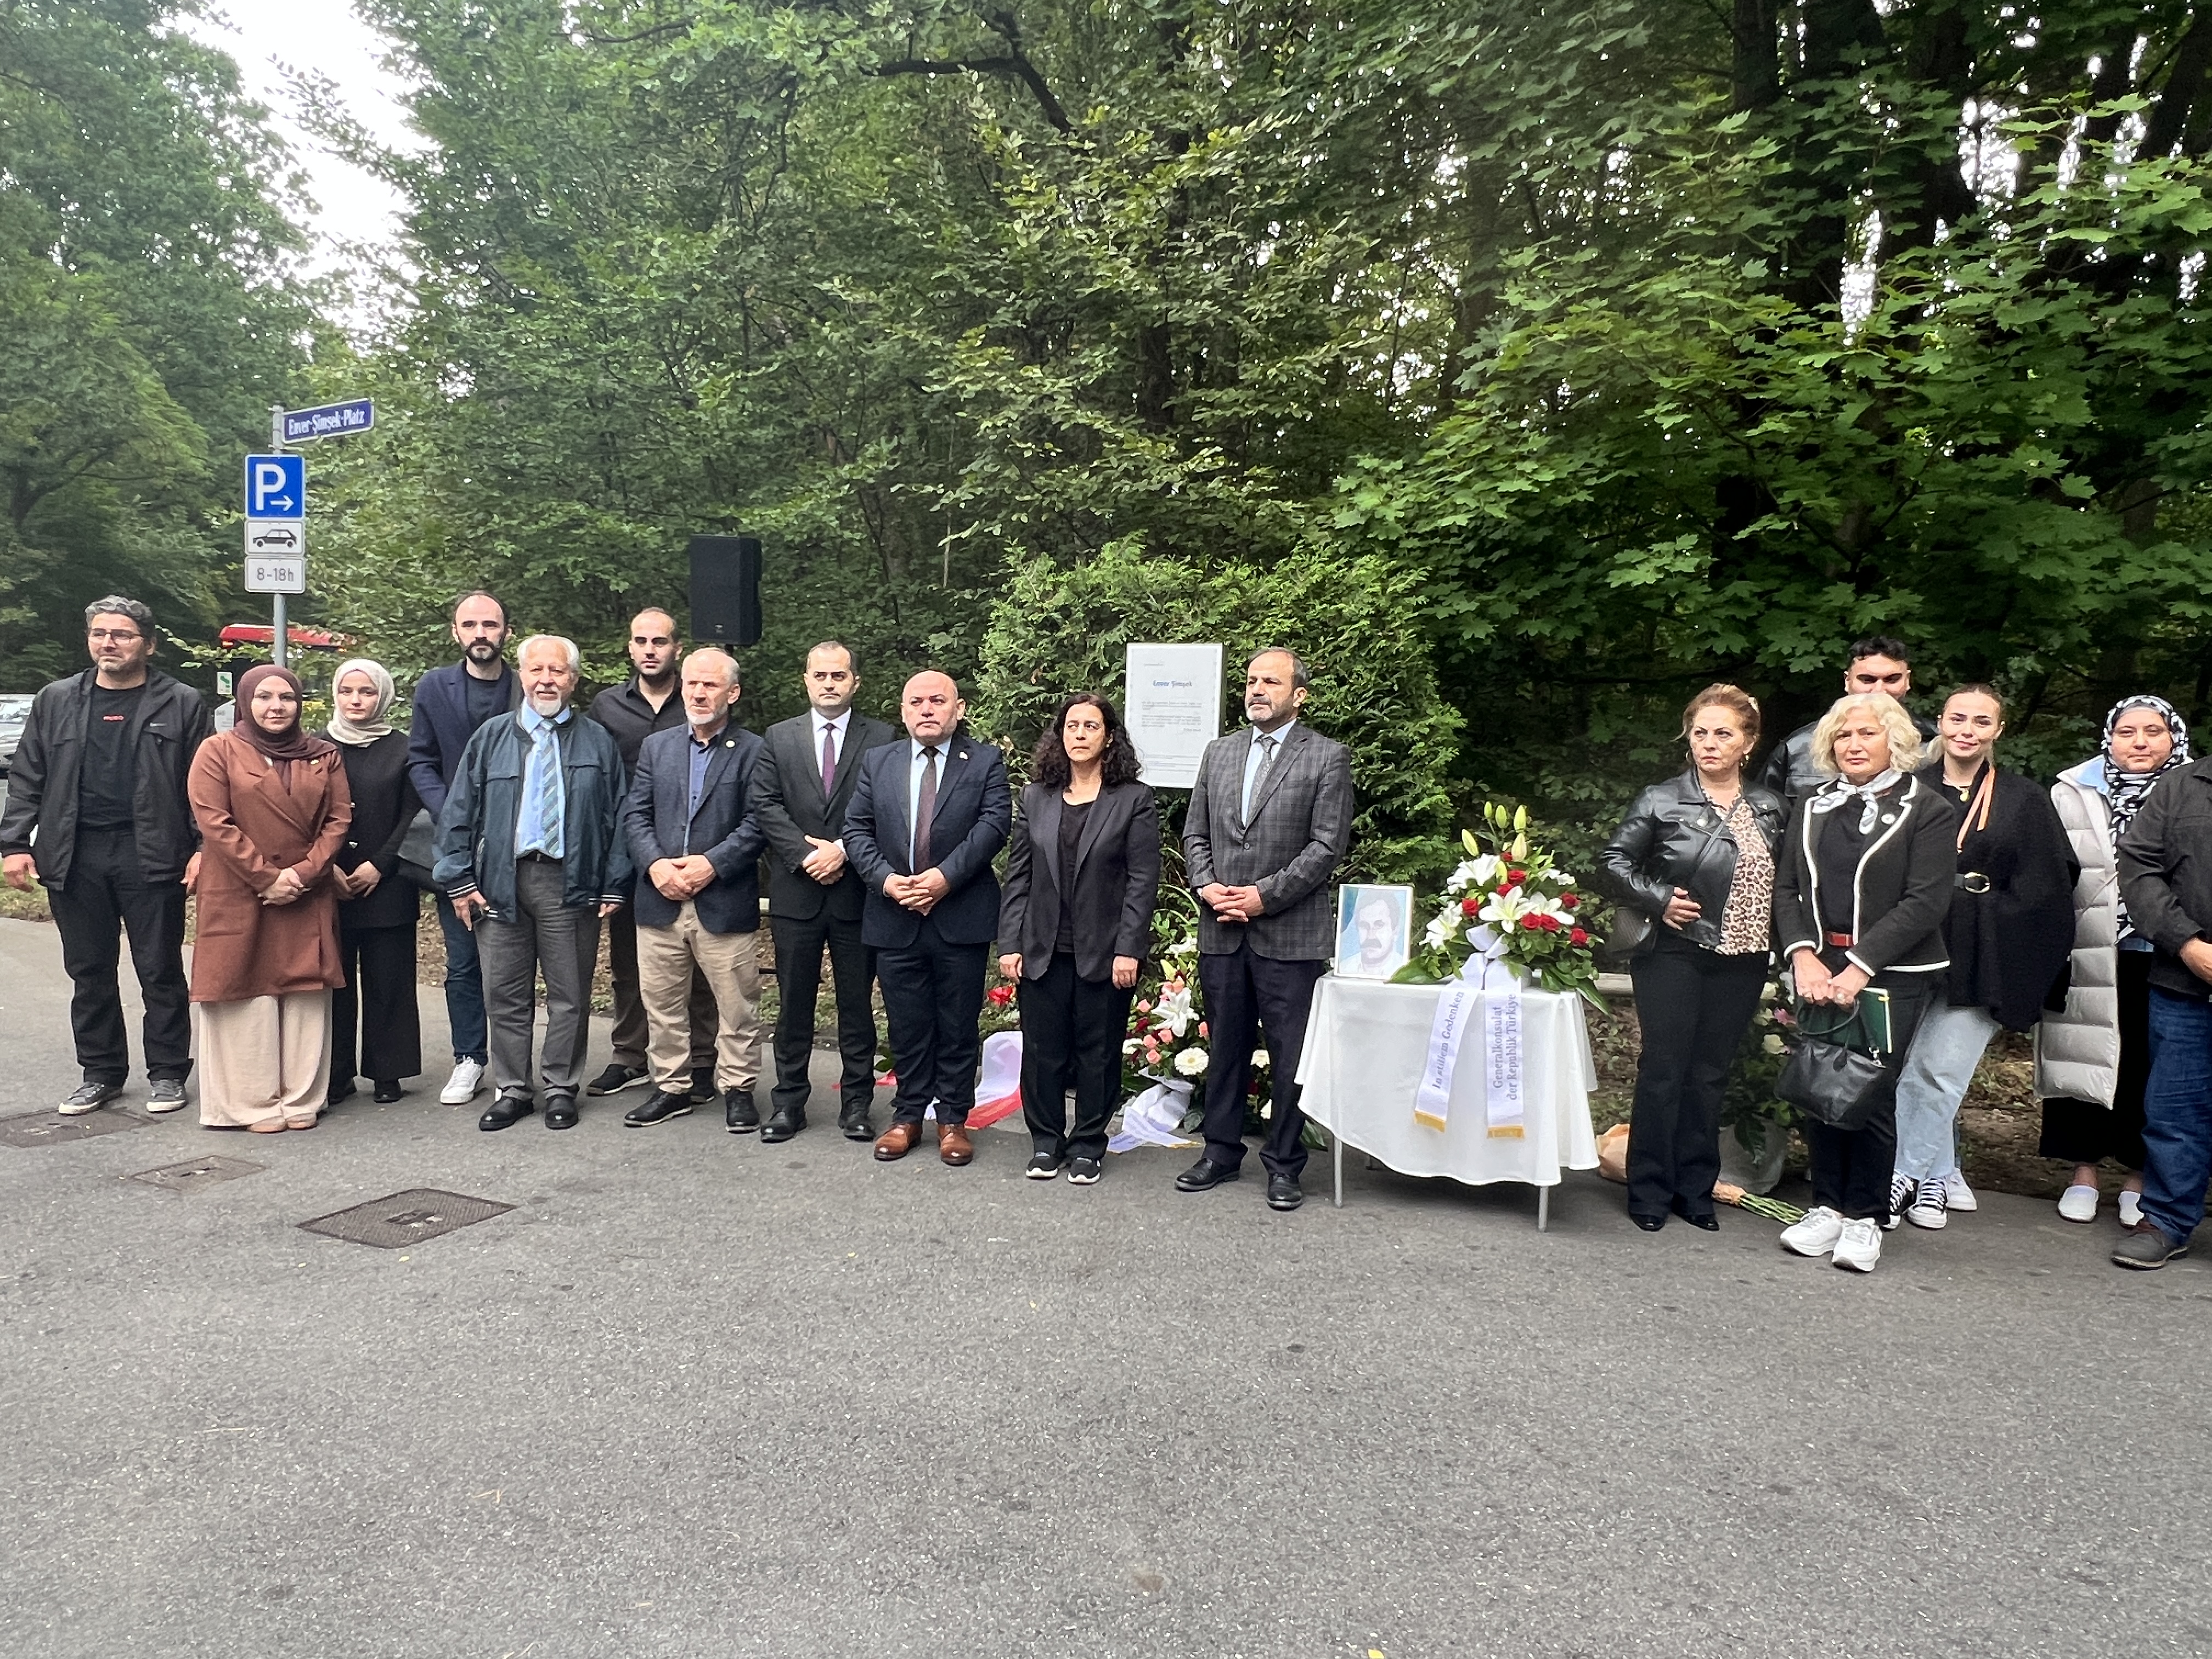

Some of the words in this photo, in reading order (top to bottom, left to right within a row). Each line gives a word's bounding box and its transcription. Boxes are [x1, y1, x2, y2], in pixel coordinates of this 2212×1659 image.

[256, 464, 286, 511] P
[1442, 991, 1465, 1039] Gedenken
[1505, 994, 1519, 1035] Türkiye
[1435, 1042, 1448, 1076] stillem
[1491, 1006, 1504, 1088] Generalkonsulat
[1505, 1036, 1519, 1080] Republik
[1432, 1077, 1442, 1089] In
[1506, 1082, 1517, 1101] der
